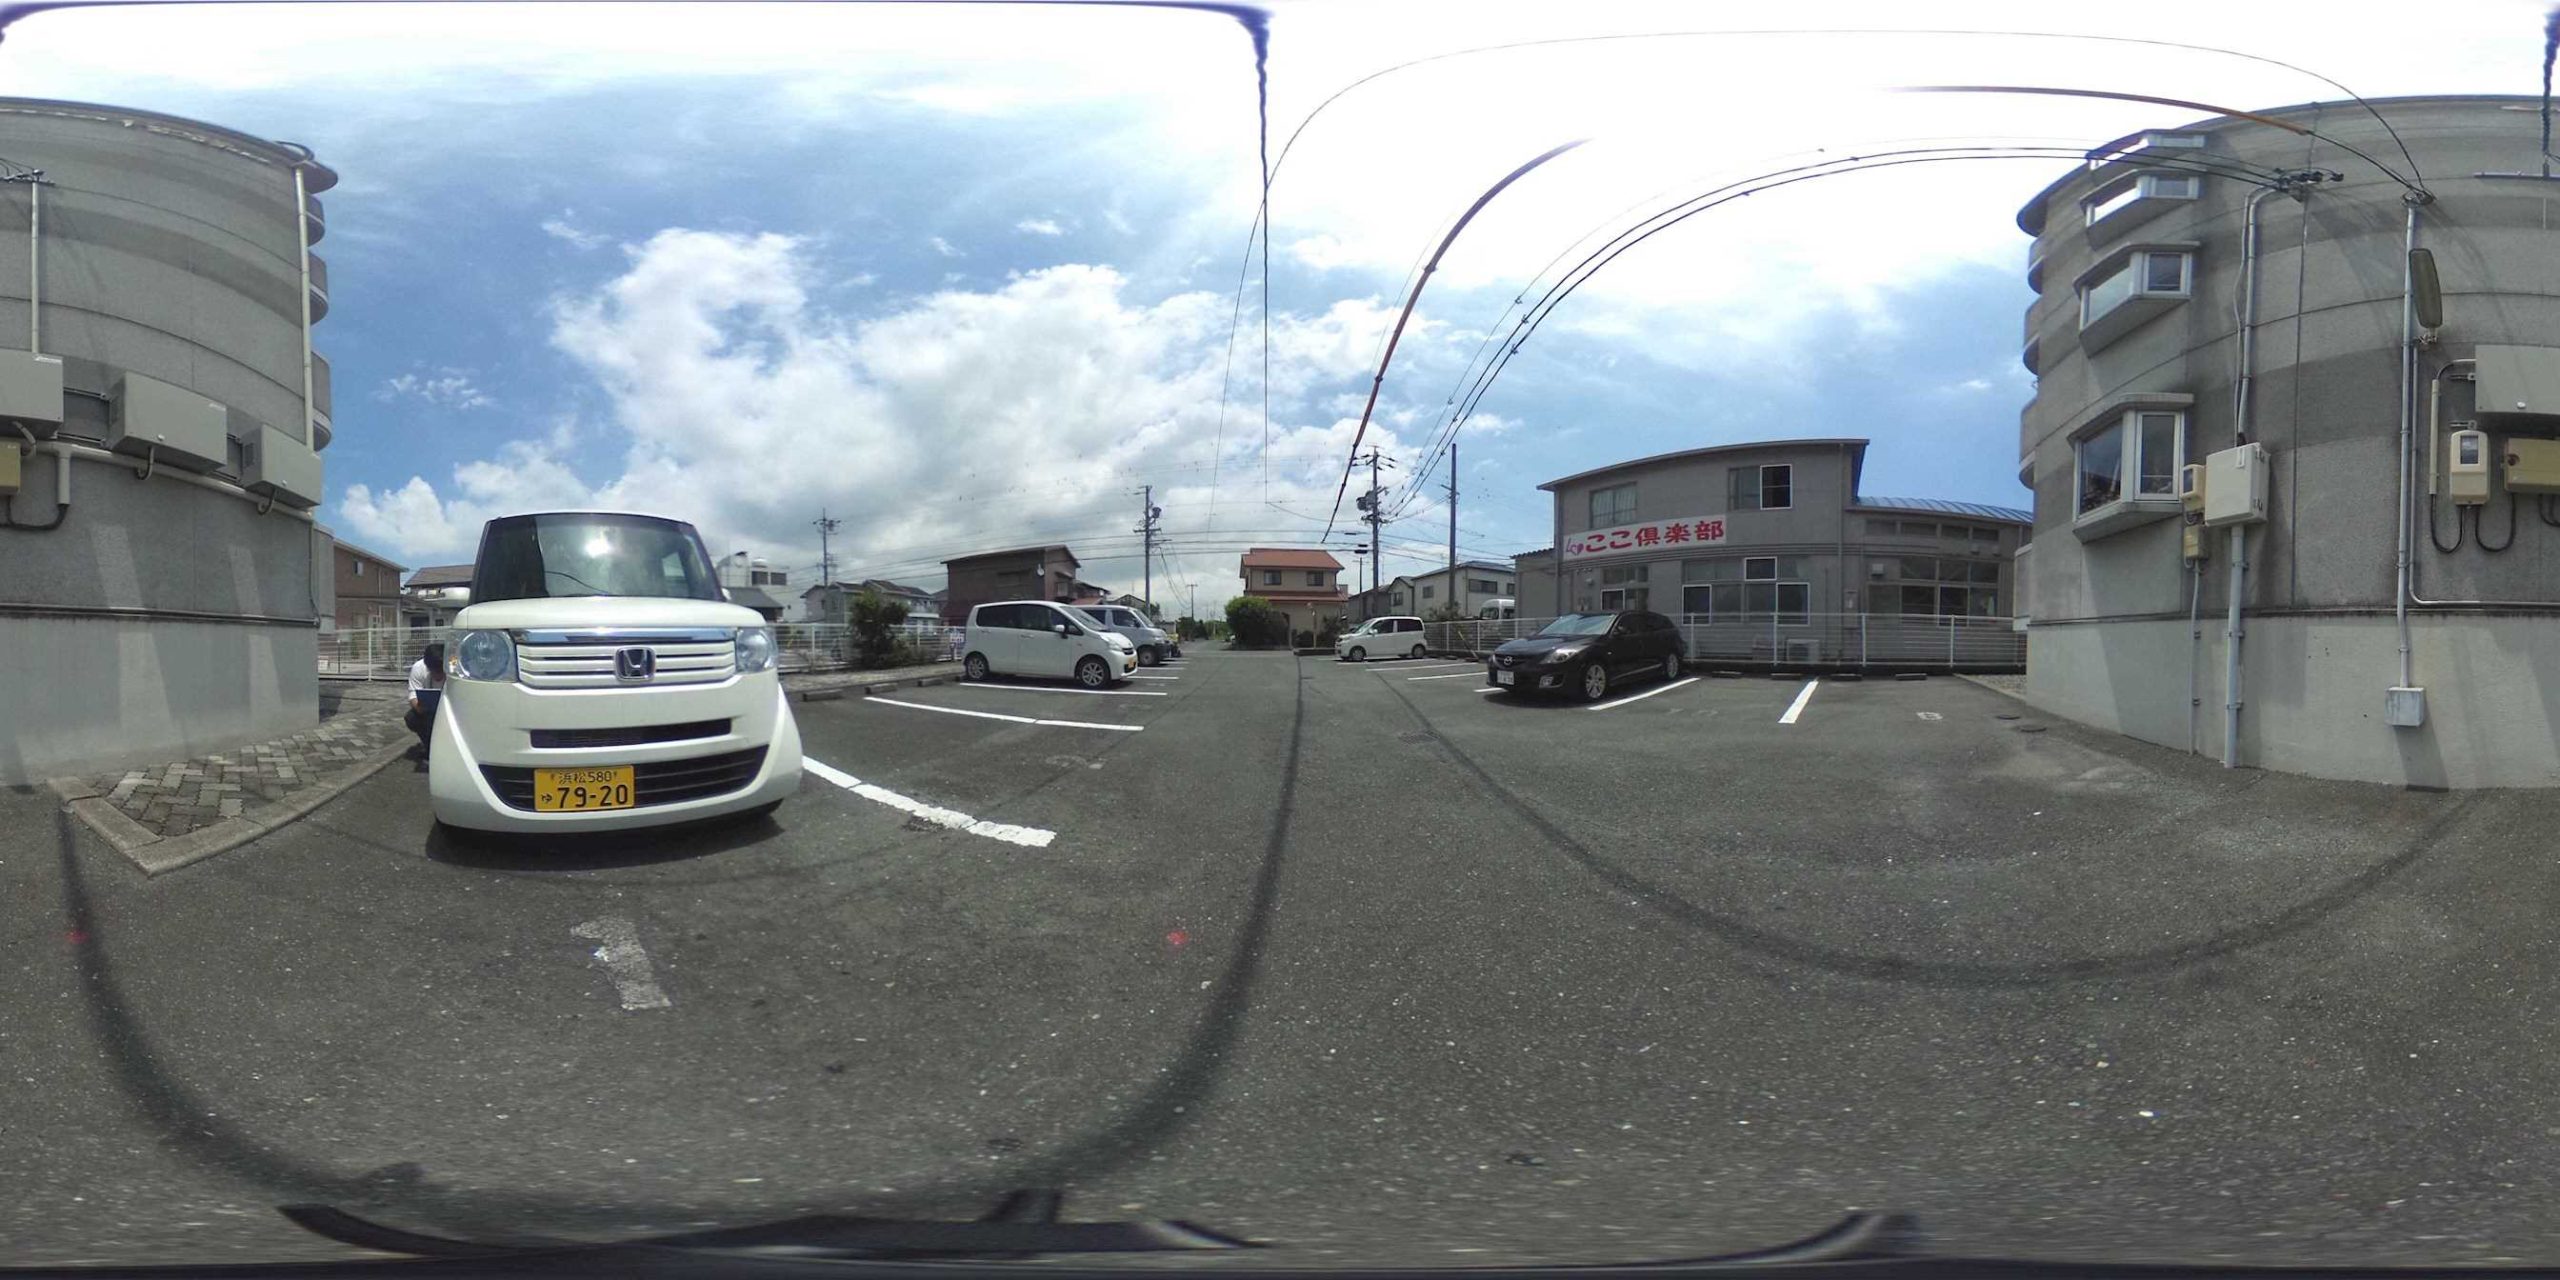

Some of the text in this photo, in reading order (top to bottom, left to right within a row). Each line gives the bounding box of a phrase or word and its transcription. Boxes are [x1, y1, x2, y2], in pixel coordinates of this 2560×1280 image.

[1585, 520, 1725, 553] ここ倶楽部
[557, 784, 628, 808] 79-20
